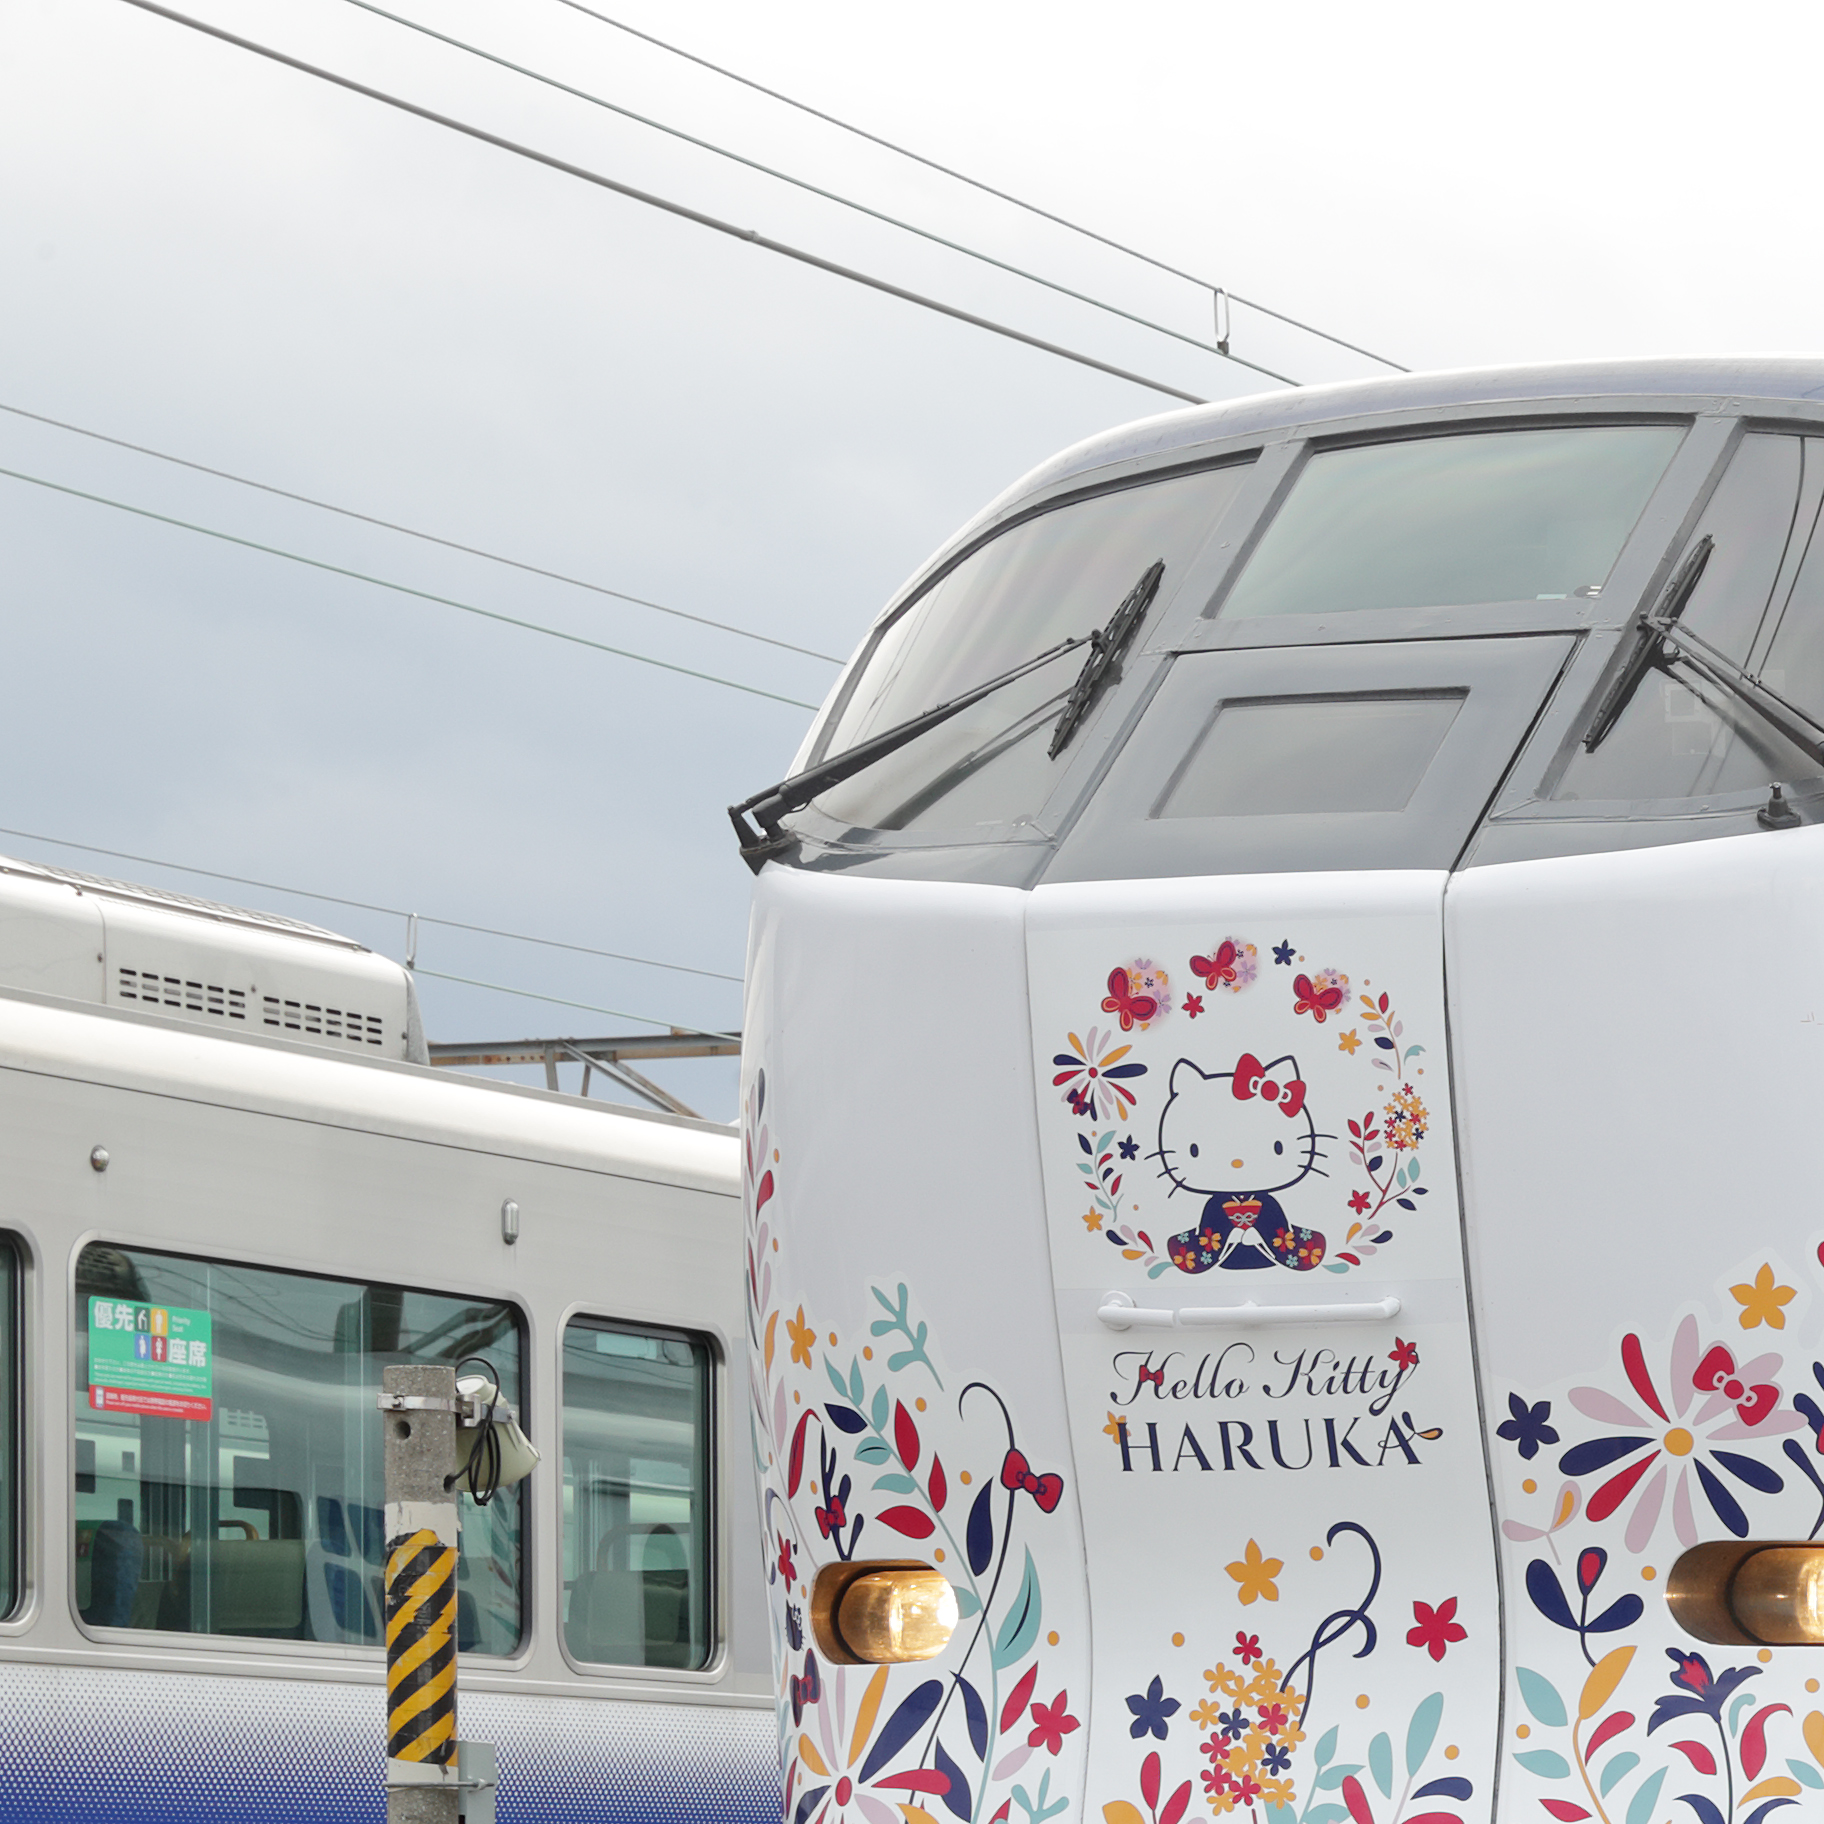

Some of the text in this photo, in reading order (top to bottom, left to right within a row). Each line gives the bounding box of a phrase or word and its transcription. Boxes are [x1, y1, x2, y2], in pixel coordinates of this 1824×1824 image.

[94, 1301, 134, 1332] 優先
[168, 1338, 207, 1367] 座席
[1110, 1342, 1418, 1417] Hello Kitty
[1117, 1413, 1424, 1472] HARUKA
